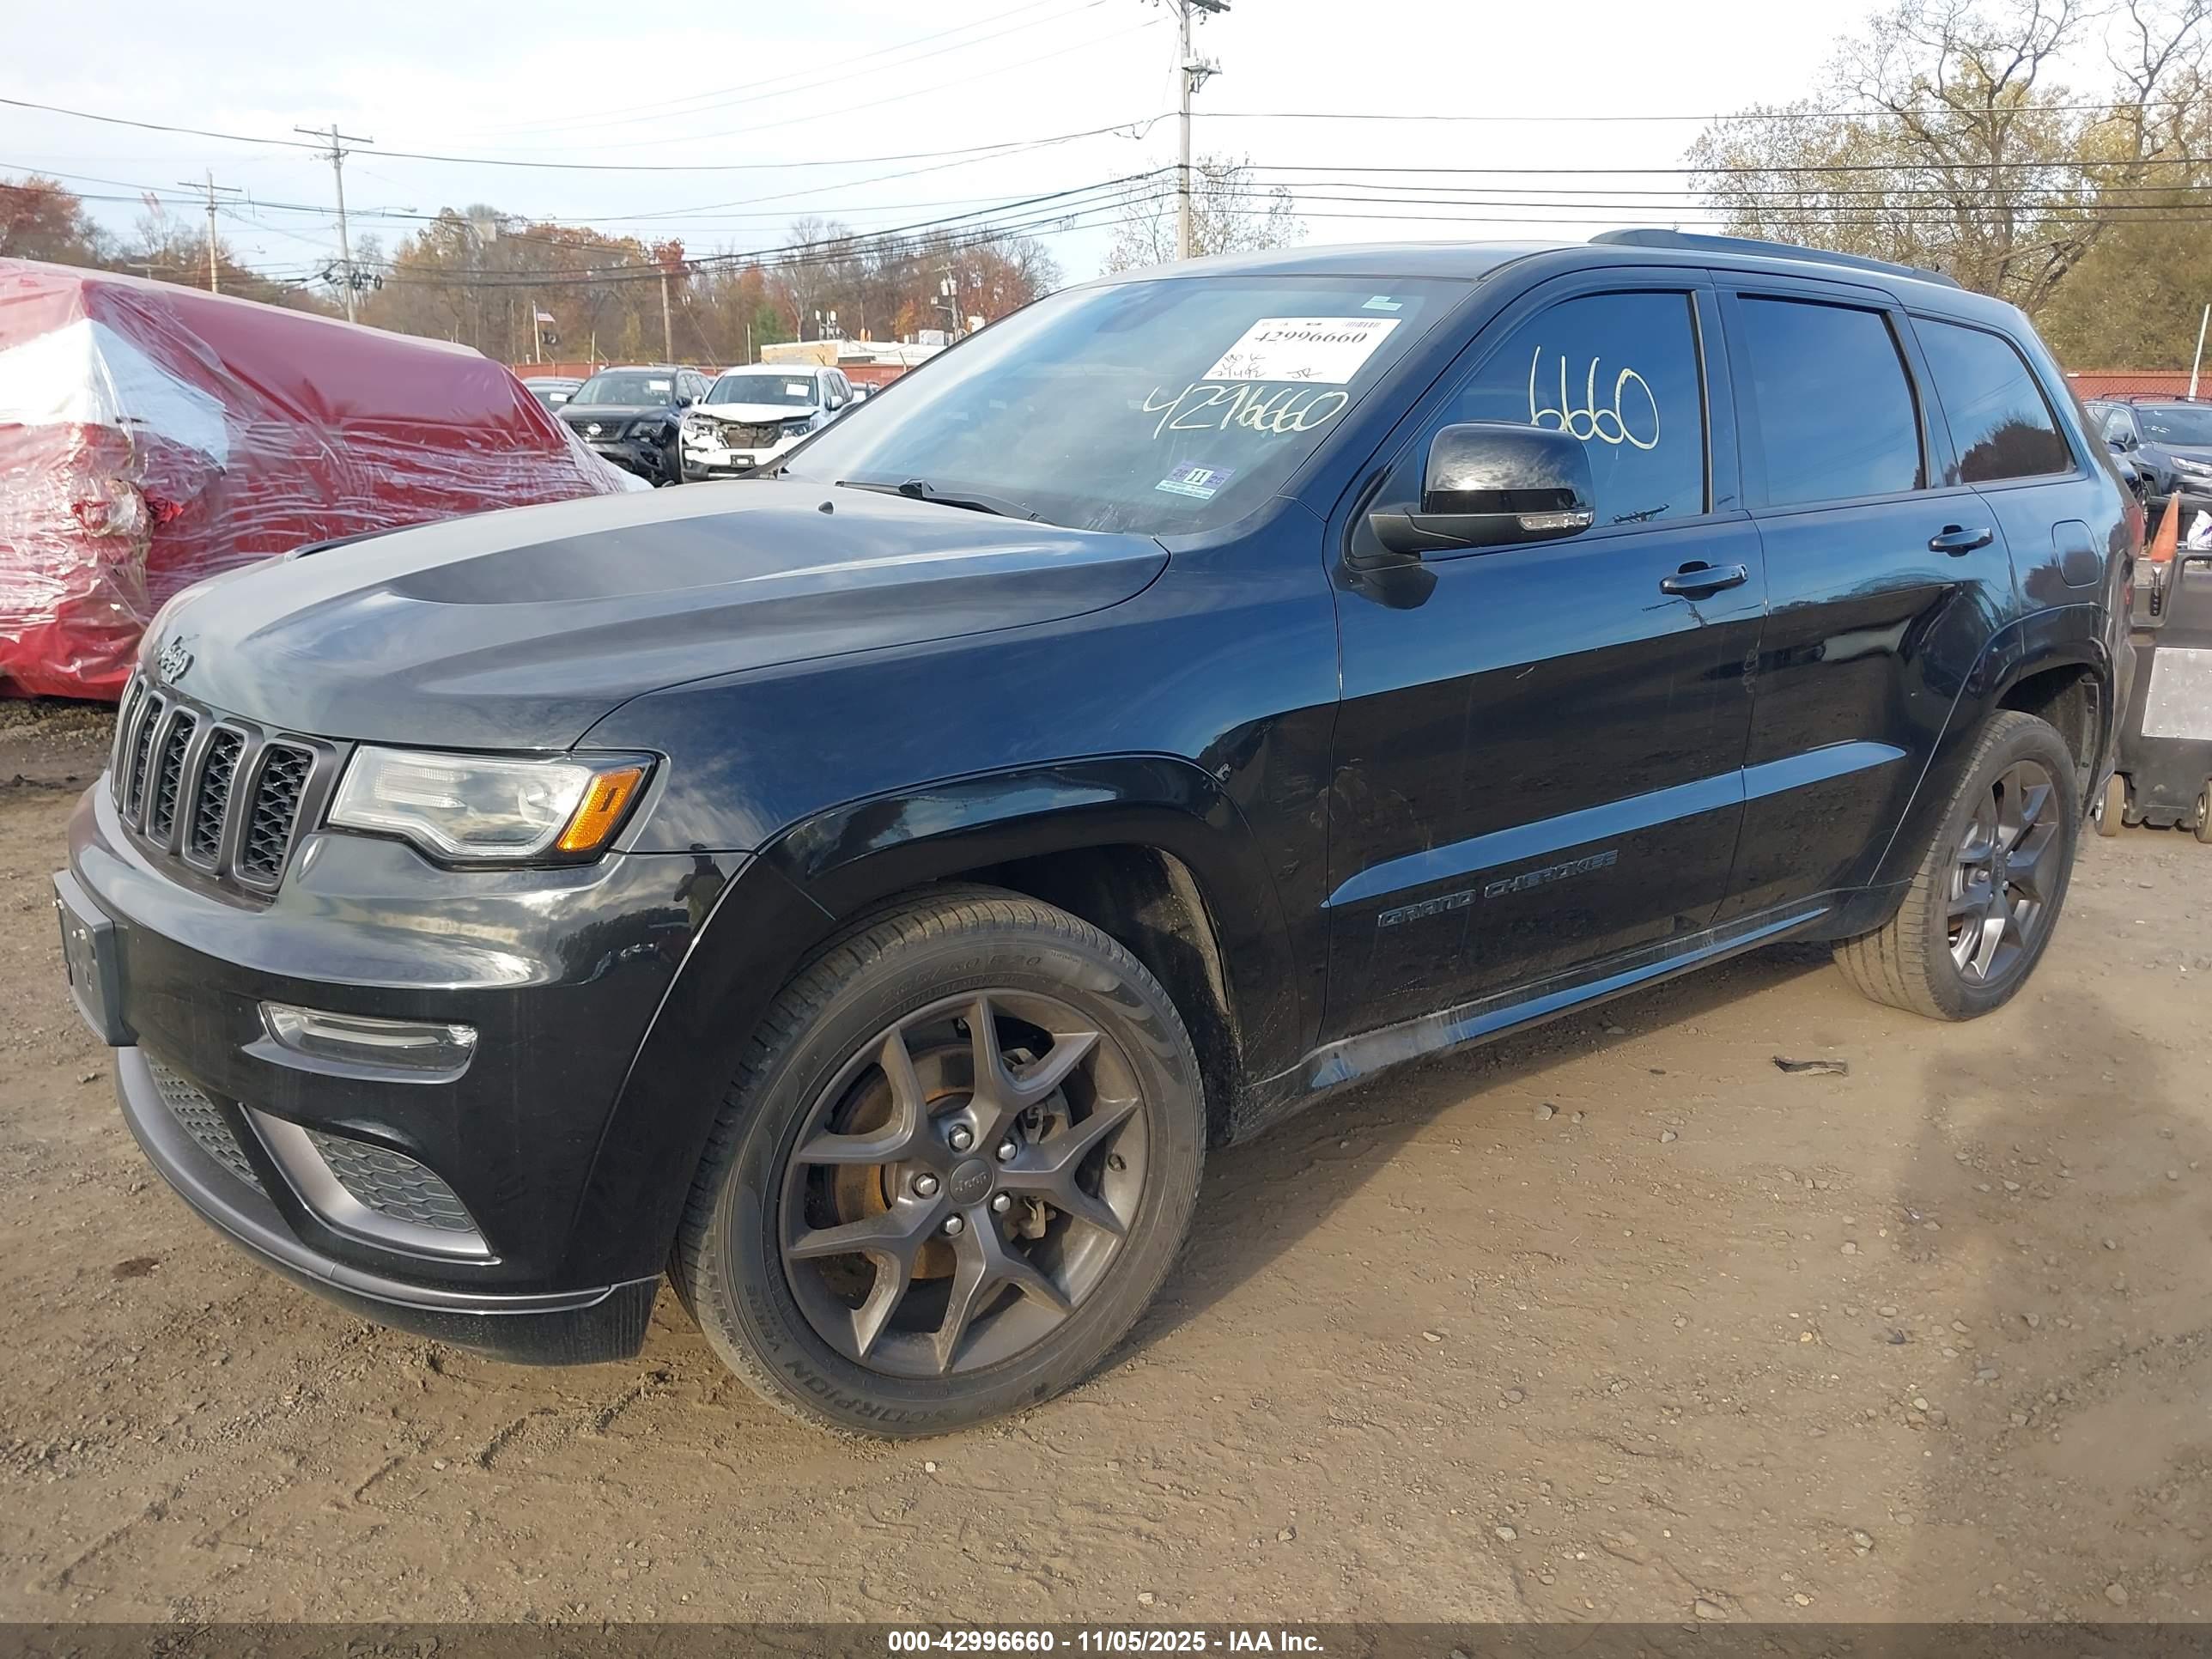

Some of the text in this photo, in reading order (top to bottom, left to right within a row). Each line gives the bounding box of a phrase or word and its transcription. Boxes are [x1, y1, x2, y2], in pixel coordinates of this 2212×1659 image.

[1255, 331, 1368, 343] 42996660
[1529, 346, 1660, 450] 6660
[1187, 470, 1208, 483] 11
[1378, 849, 1619, 927] GRAND CHEROKEE
